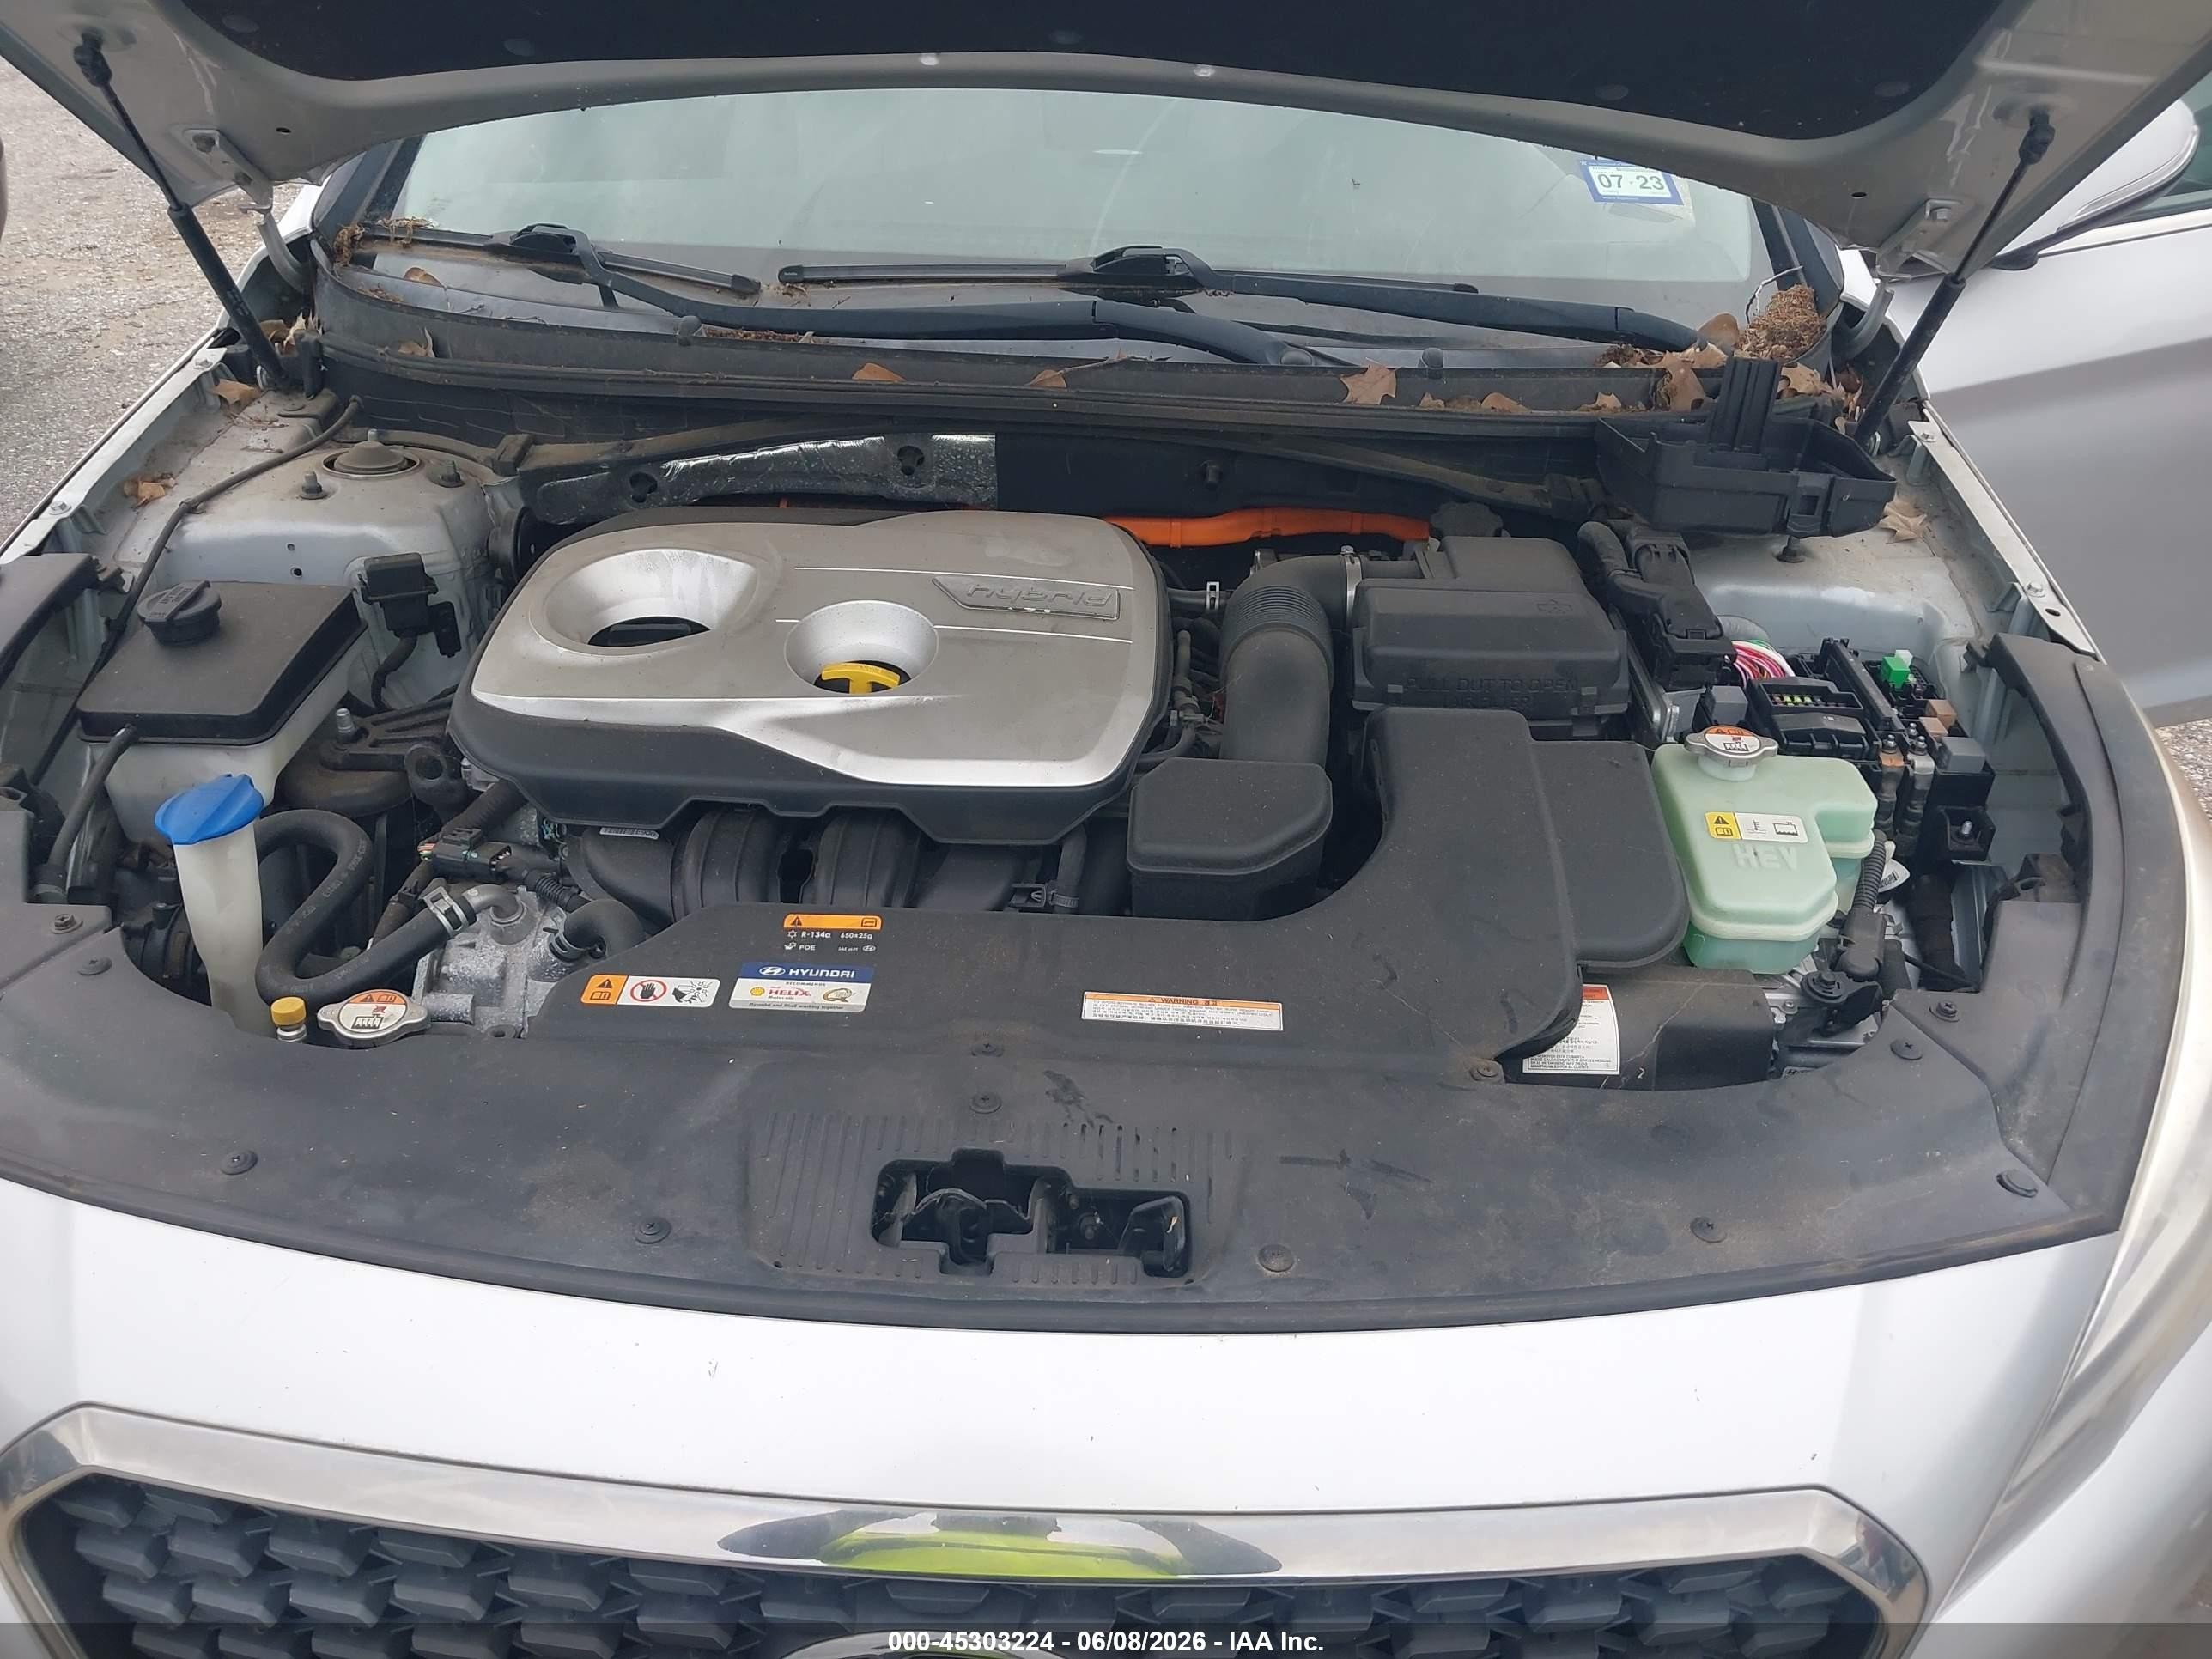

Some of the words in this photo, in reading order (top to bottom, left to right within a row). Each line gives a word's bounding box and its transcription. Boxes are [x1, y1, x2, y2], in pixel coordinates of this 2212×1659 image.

[1733, 843, 1798, 871] HEV
[788, 968, 856, 978] HYUNDAI
[768, 988, 811, 997] HELIX
[1160, 997, 1199, 1006] WARNING
